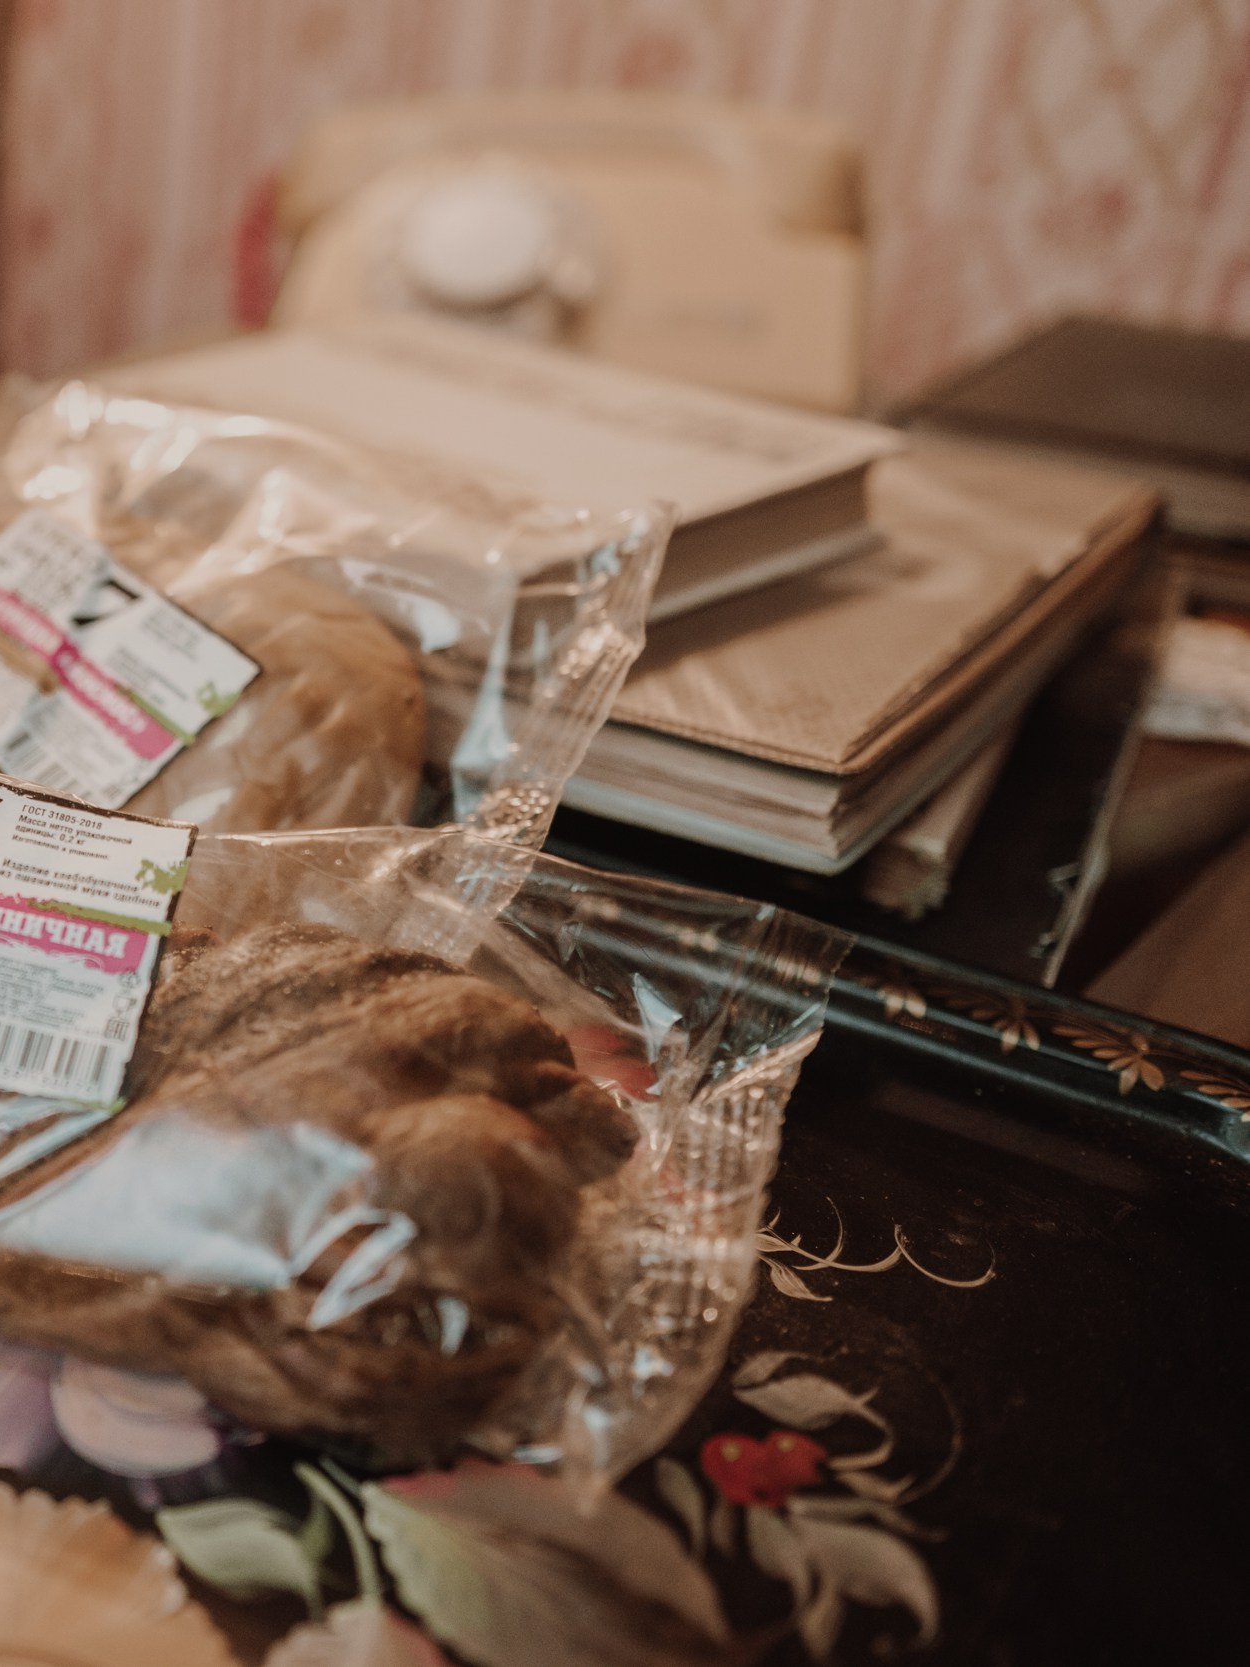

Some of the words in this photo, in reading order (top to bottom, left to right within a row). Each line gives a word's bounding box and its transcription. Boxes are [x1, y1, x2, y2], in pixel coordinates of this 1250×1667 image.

[22, 804, 46, 816] ГОСТ
[48, 810, 103, 830] 31805-2018
[18, 814, 47, 828] Масса
[49, 823, 73, 835] нетто
[75, 828, 133, 845] упаковочной
[0, 869, 12, 878] из
[2, 857, 50, 877] Изделие
